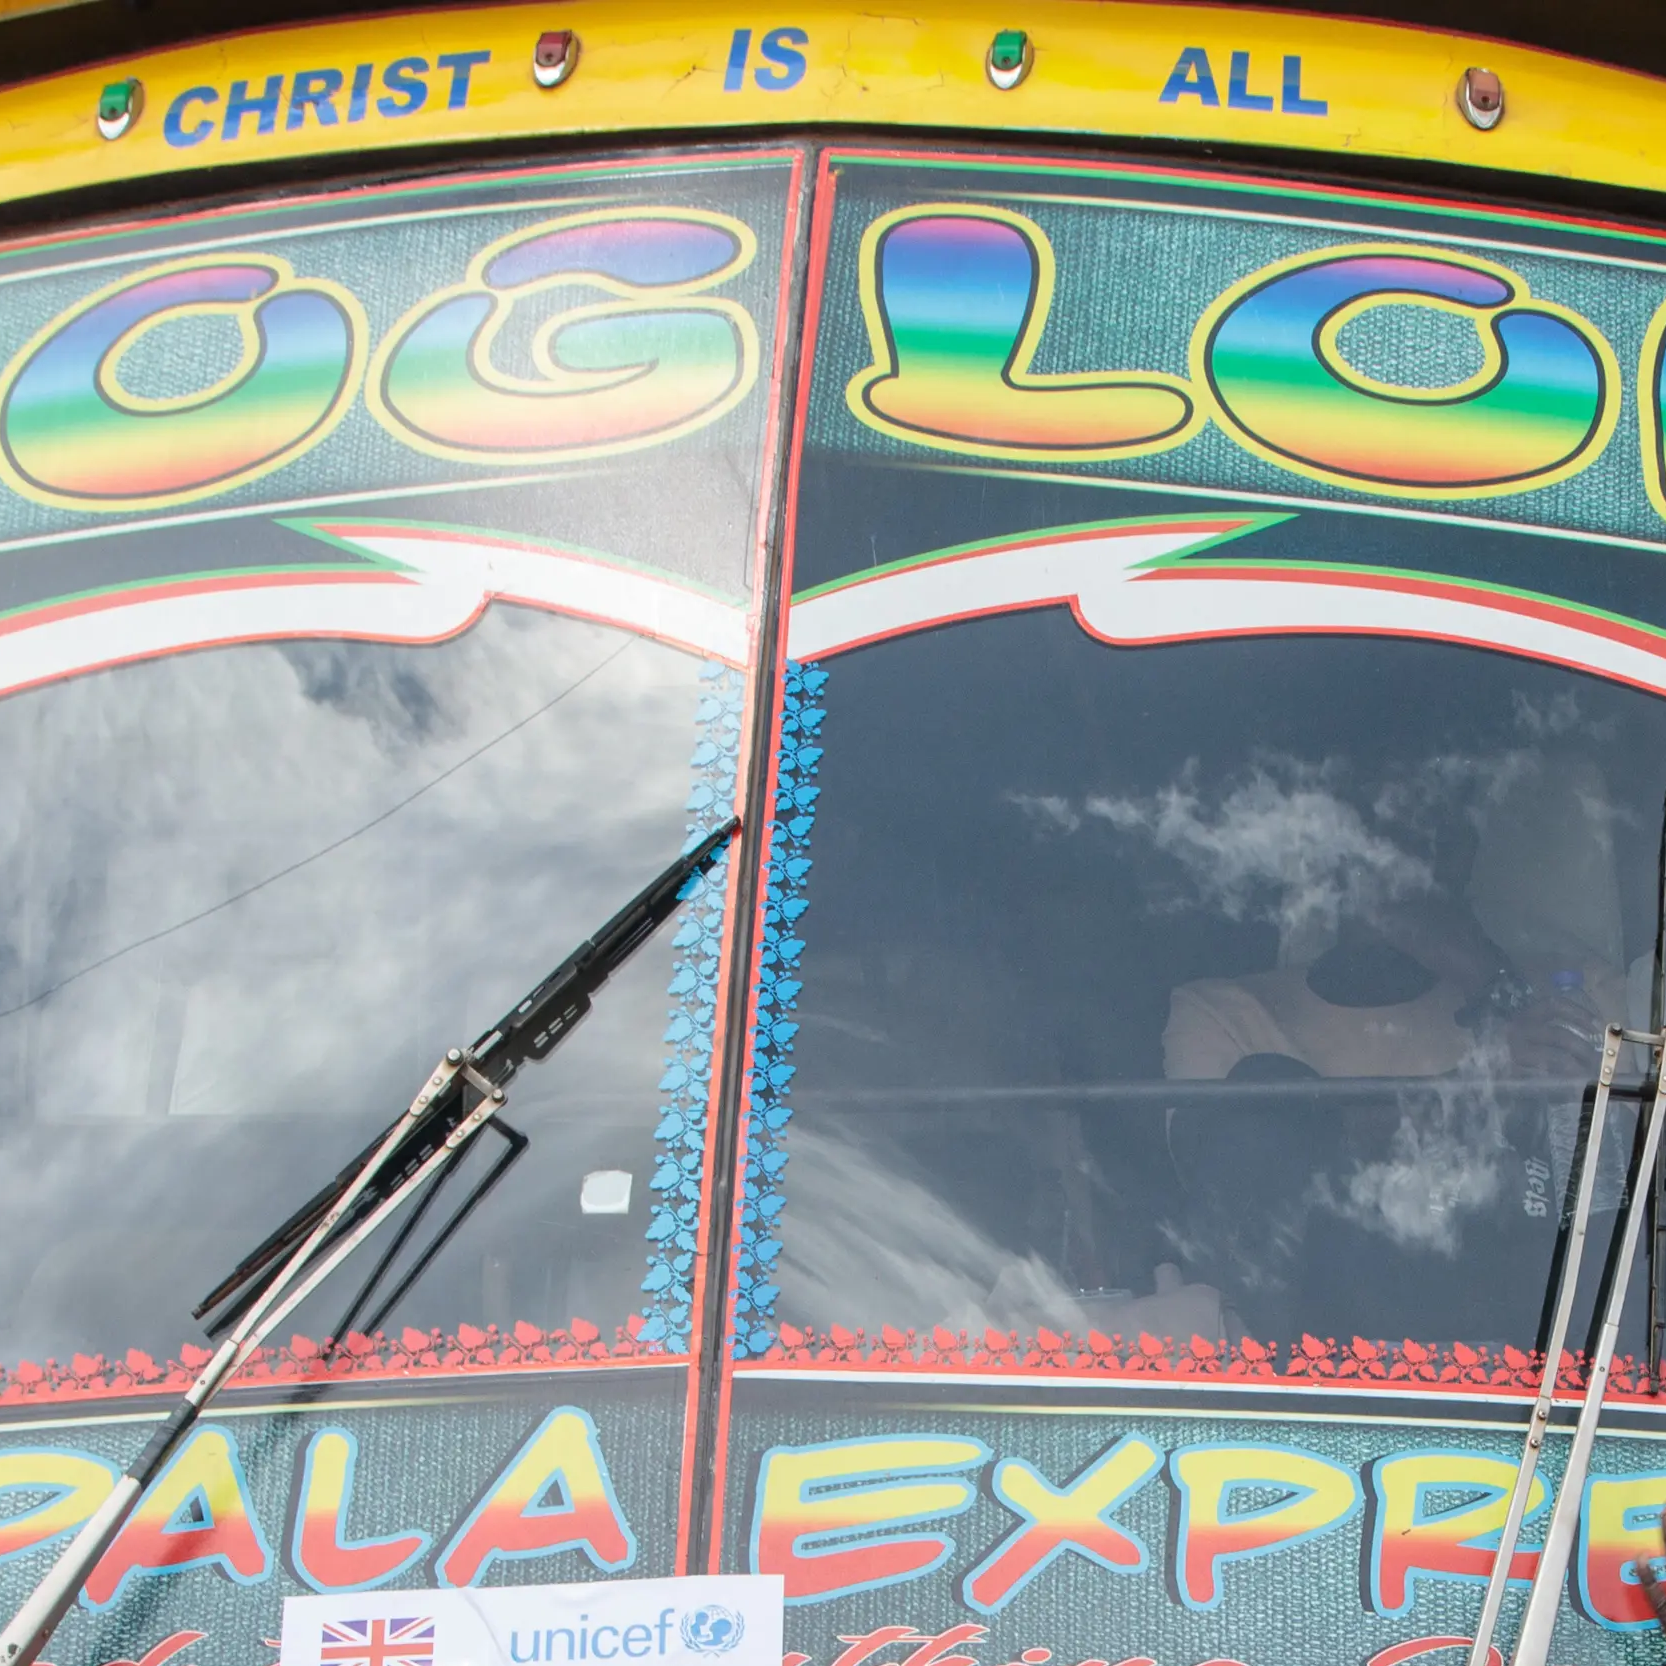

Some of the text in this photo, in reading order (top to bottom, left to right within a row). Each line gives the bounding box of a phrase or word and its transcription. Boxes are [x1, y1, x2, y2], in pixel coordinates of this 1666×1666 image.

[163, 26, 1328, 149] CHRIST IS ALL
[509, 1607, 675, 1664] unicef
